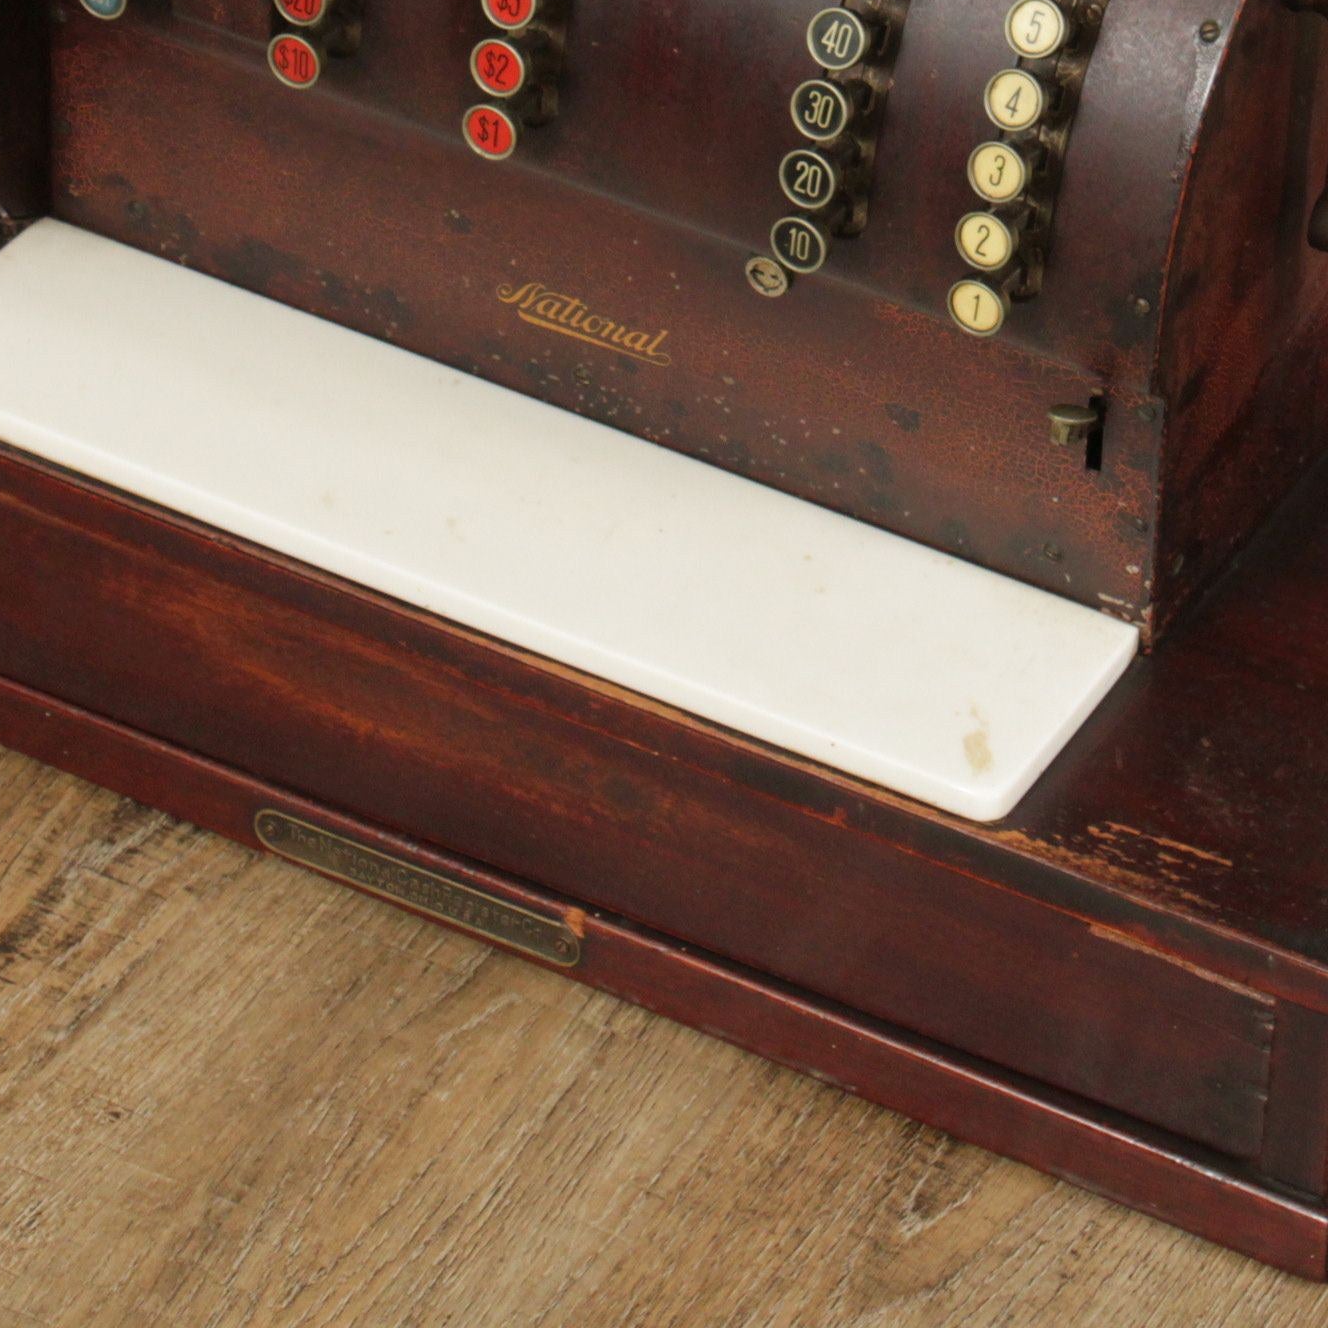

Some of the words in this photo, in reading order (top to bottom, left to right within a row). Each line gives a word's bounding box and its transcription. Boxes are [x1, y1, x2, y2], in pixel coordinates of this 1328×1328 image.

[821, 18, 853, 59] 40
[1025, 9, 1046, 44] 5
[278, 43, 309, 80] $10
[483, 50, 510, 86] $2
[804, 89, 833, 129] 30
[1004, 86, 1024, 119] 4
[477, 115, 501, 149] $1
[793, 160, 822, 198] 20
[988, 154, 1006, 187] 3
[788, 227, 810, 259] 10
[973, 224, 992, 258] 2
[496, 282, 672, 366] National
[971, 293, 982, 323] 1
